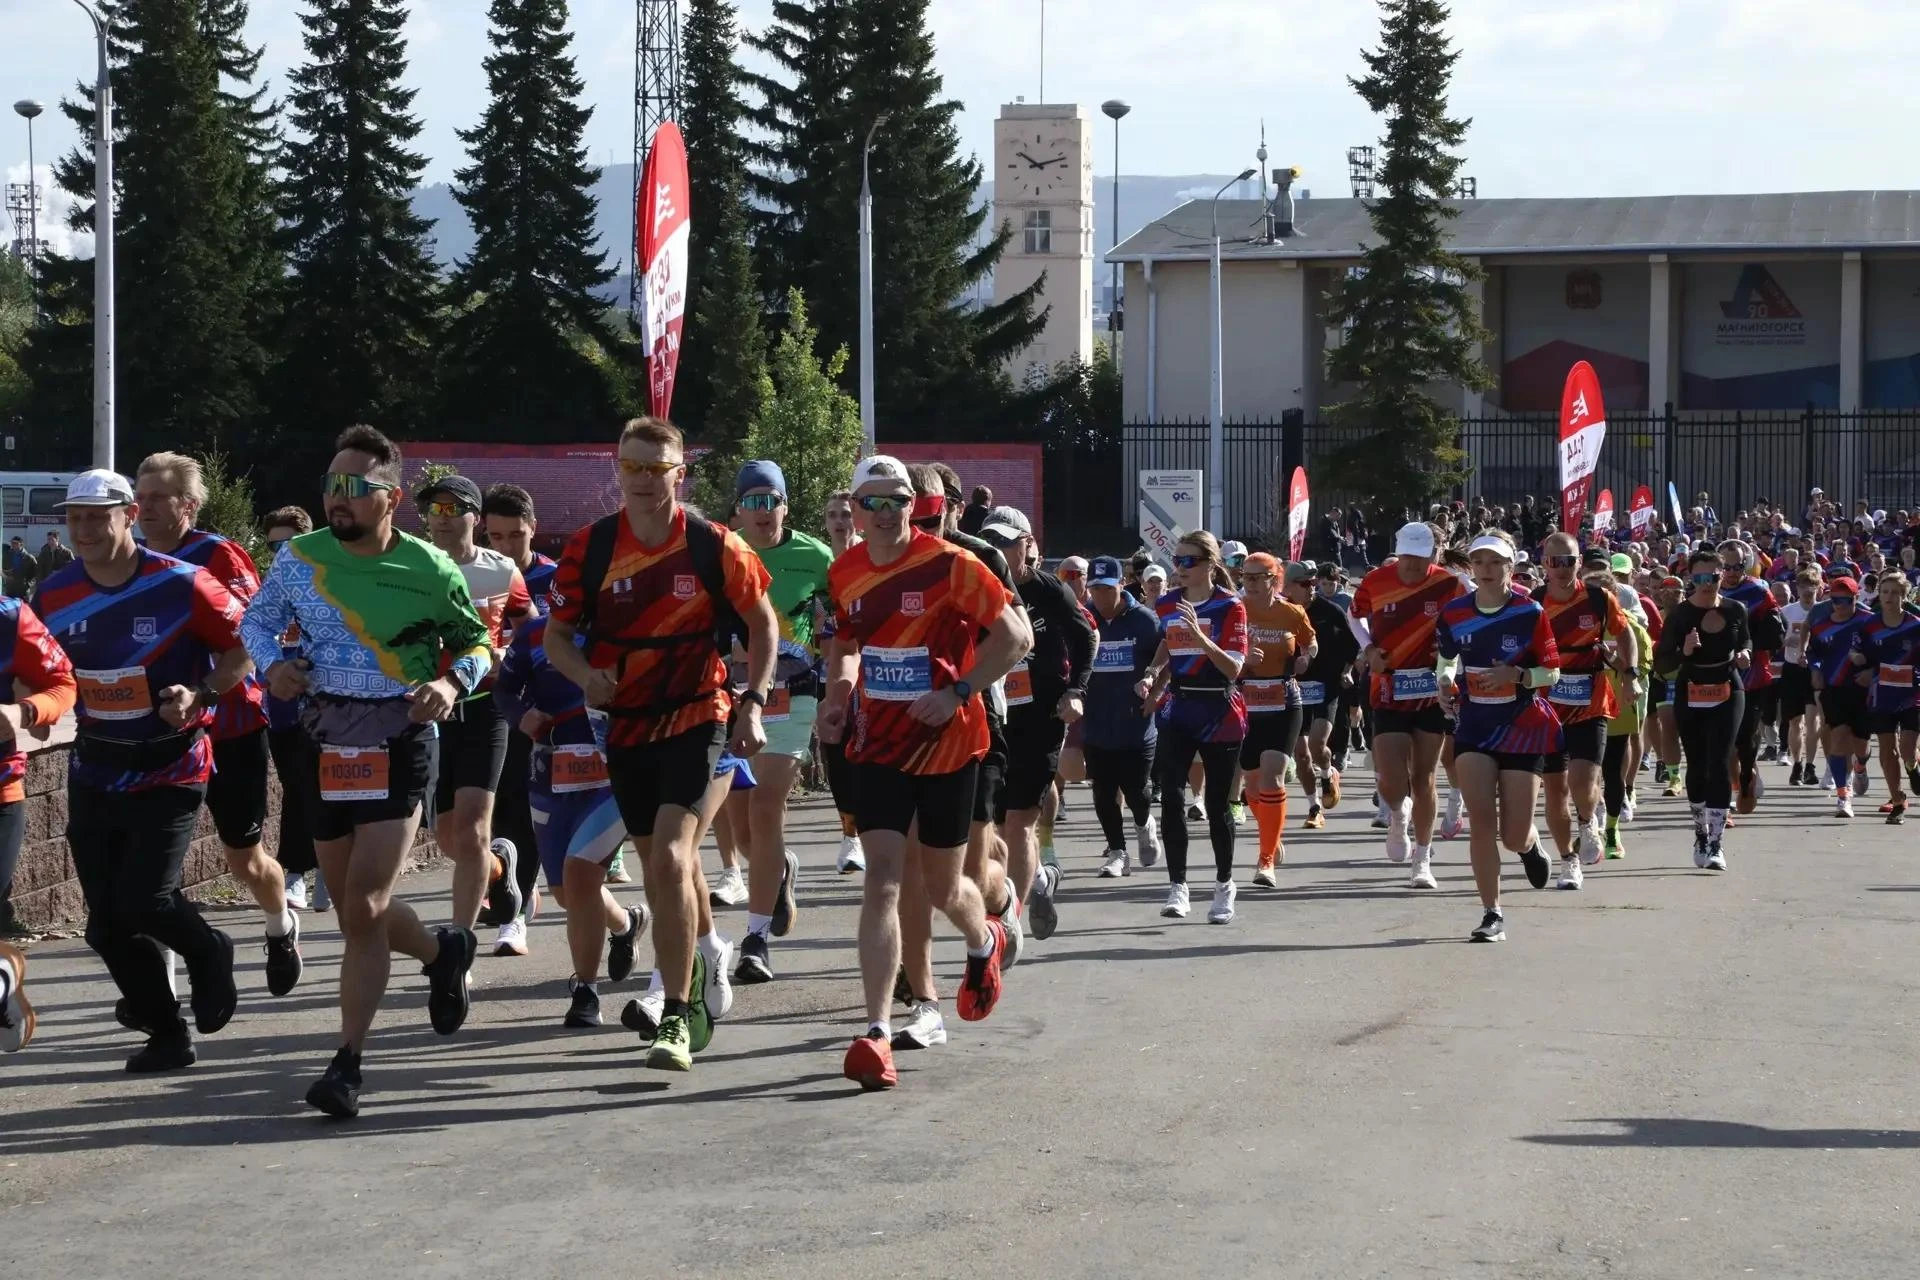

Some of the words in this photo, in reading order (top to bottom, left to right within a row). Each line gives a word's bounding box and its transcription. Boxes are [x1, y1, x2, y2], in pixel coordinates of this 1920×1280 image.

[1144, 521, 1169, 547] 706
[1102, 652, 1123, 662] 21111
[875, 666, 914, 682] 21172
[1402, 679, 1428, 689] 21173
[92, 687, 134, 702] 10382
